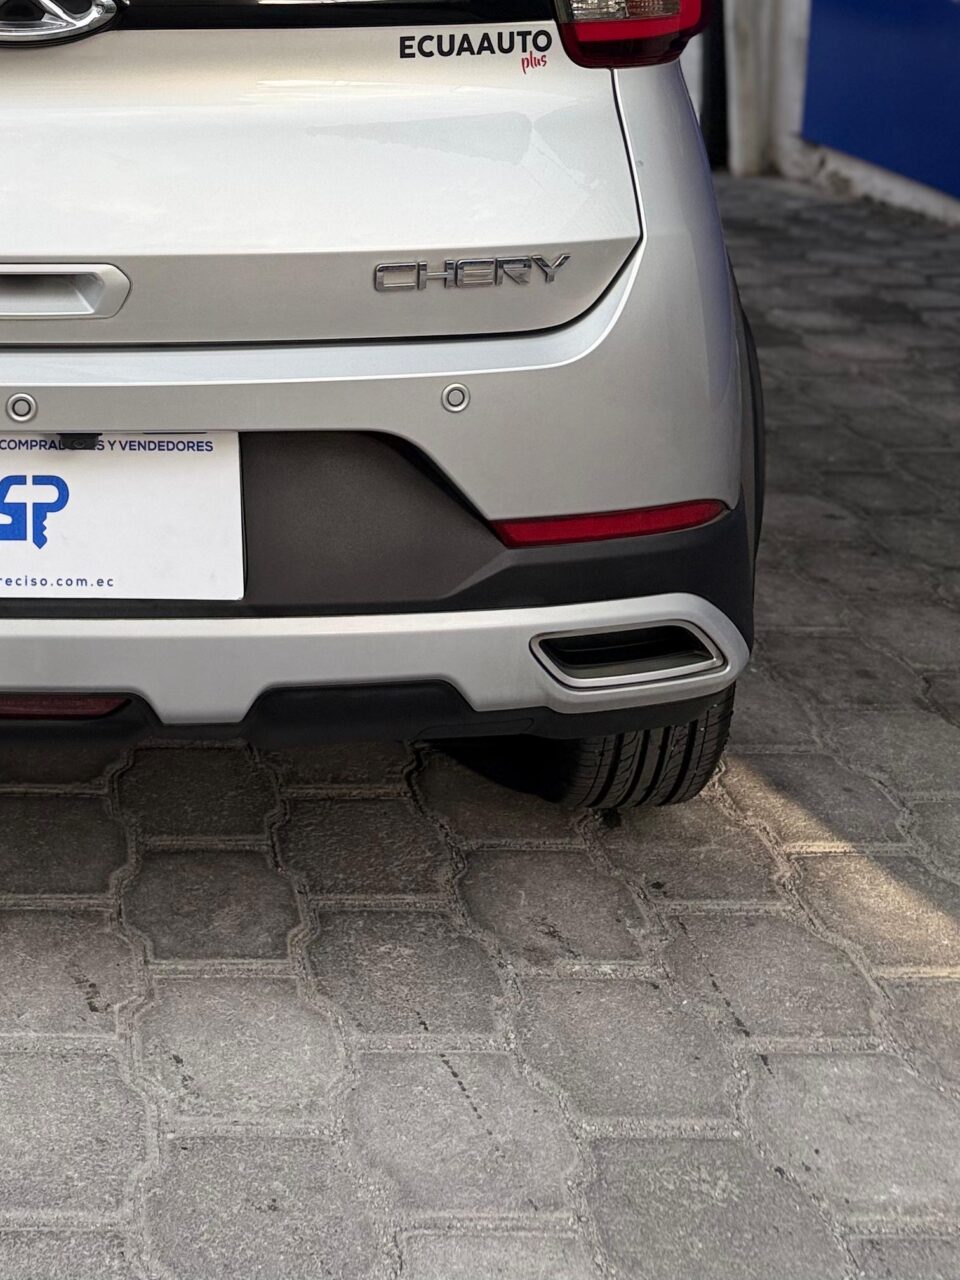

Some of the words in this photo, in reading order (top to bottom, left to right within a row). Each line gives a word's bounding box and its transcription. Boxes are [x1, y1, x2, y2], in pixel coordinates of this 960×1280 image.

[399, 30, 553, 59] ECUAAUTO
[521, 50, 547, 75] plus
[373, 253, 571, 293] CHERY
[108, 439, 117, 451] Y
[119, 440, 214, 453] VENDEDORES
